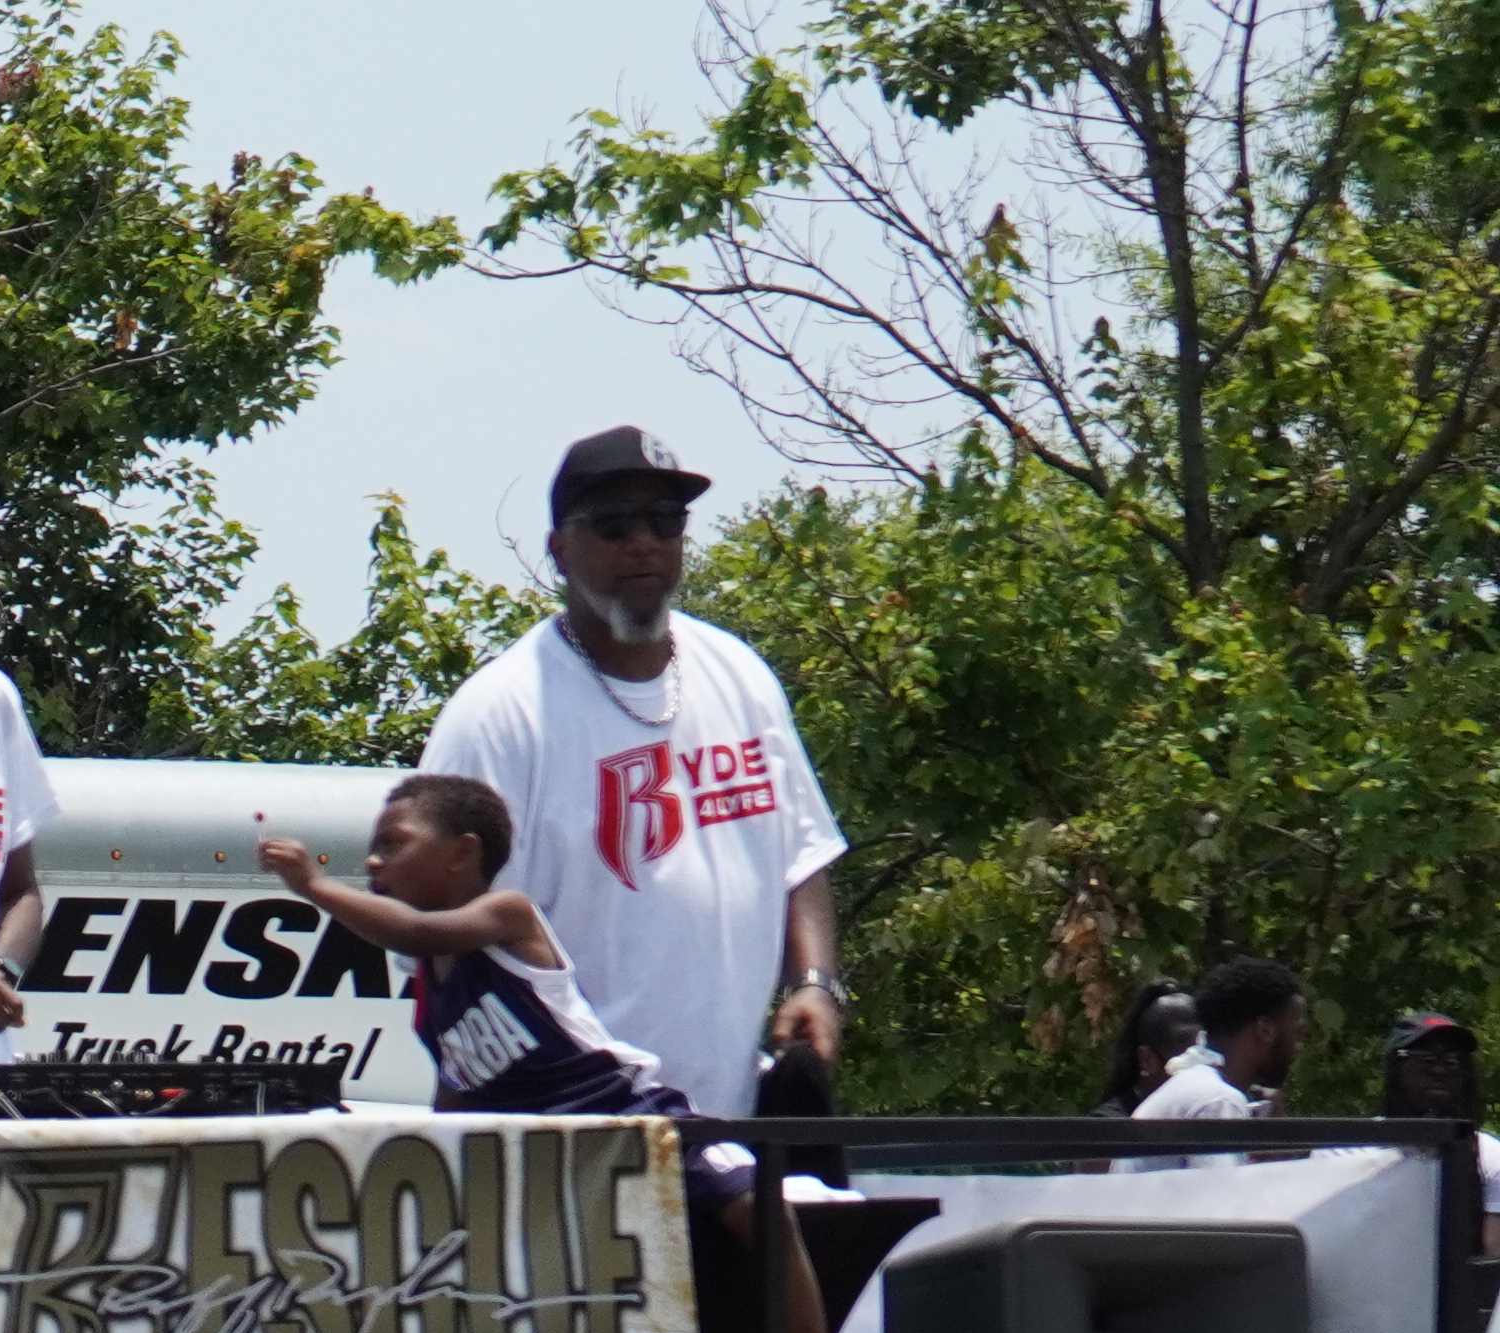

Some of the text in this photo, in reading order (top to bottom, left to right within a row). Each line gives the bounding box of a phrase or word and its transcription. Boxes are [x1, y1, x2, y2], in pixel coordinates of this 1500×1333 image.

[594, 737, 768, 893] RYDE
[15, 896, 416, 1001] ENSK
[52, 1021, 383, 1082] Truck Rental
